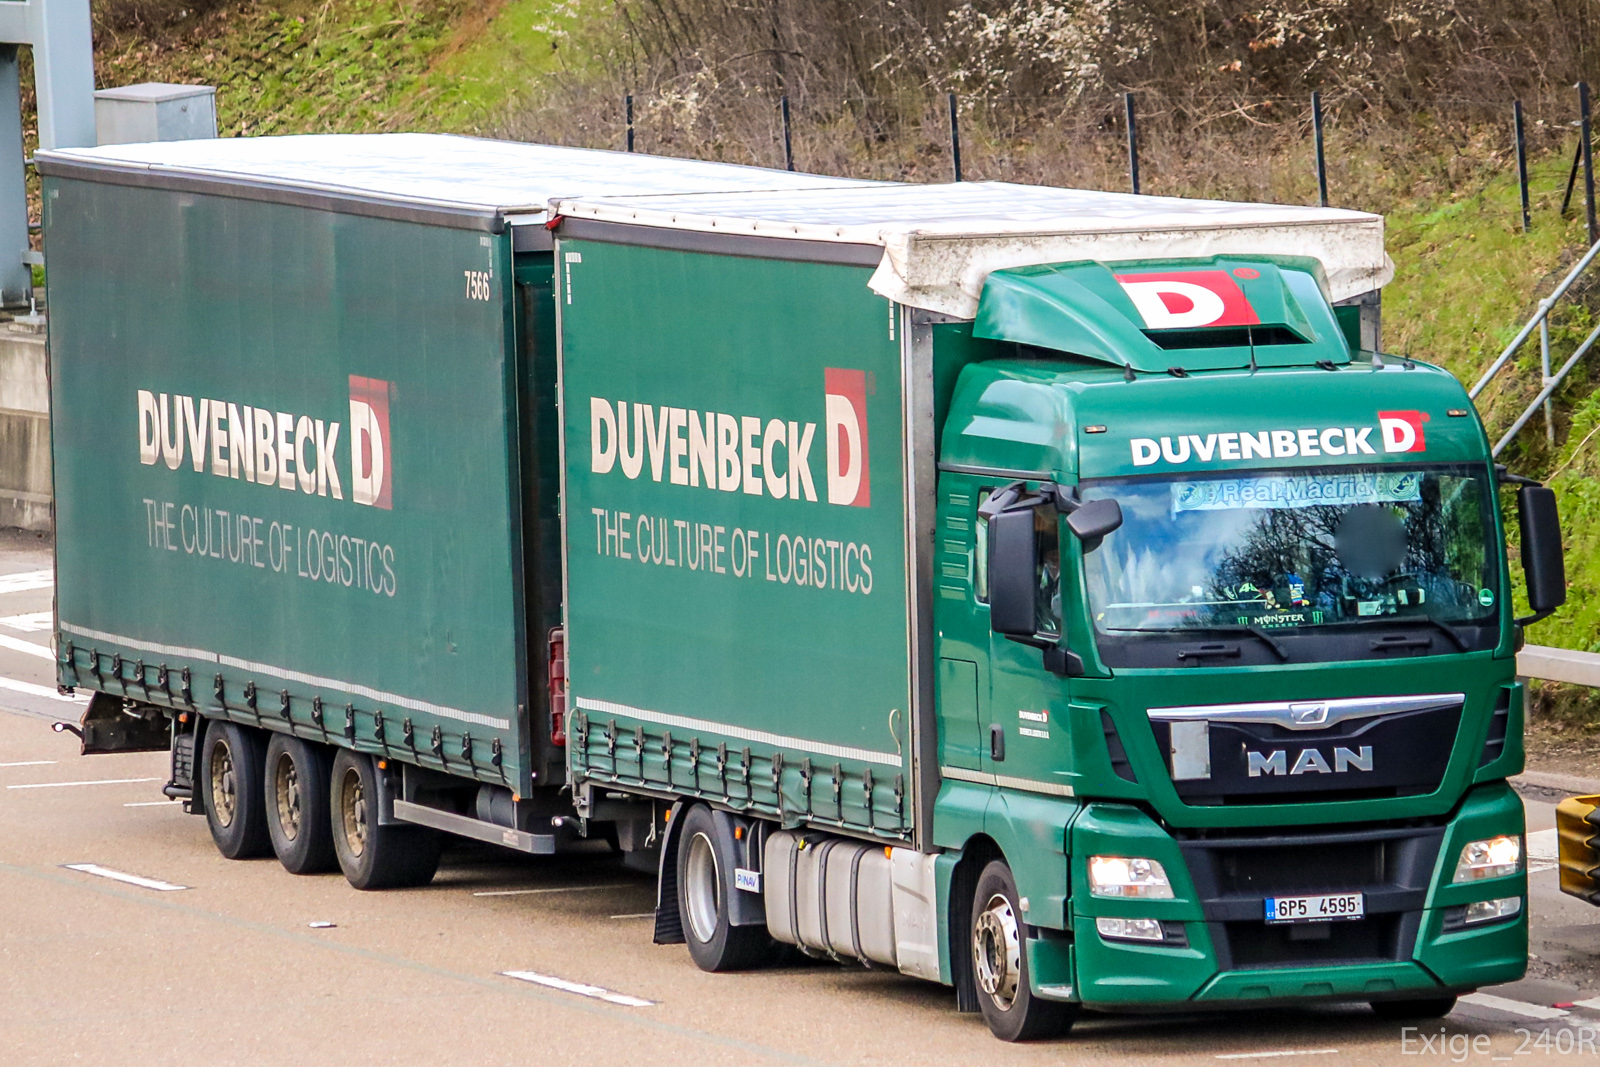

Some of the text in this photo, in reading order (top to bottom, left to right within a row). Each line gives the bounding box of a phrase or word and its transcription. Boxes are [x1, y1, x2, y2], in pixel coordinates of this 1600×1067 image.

[464, 270, 490, 301] 7566
[1119, 281, 1225, 329] D
[137, 389, 343, 500] DUVENBECK
[590, 396, 818, 503] DUVENBECK
[1129, 426, 1376, 467] DUVENBECK
[1222, 477, 1373, 502] Real Madrid
[142, 498, 396, 598] THE CULTURE OF LOGISTICS
[591, 507, 873, 596] THE CULTURE OF LOGISTICS
[1253, 613, 1306, 625] MONSTER
[1247, 745, 1374, 777] MAN
[1278, 896, 1356, 917] 6P5 4595
